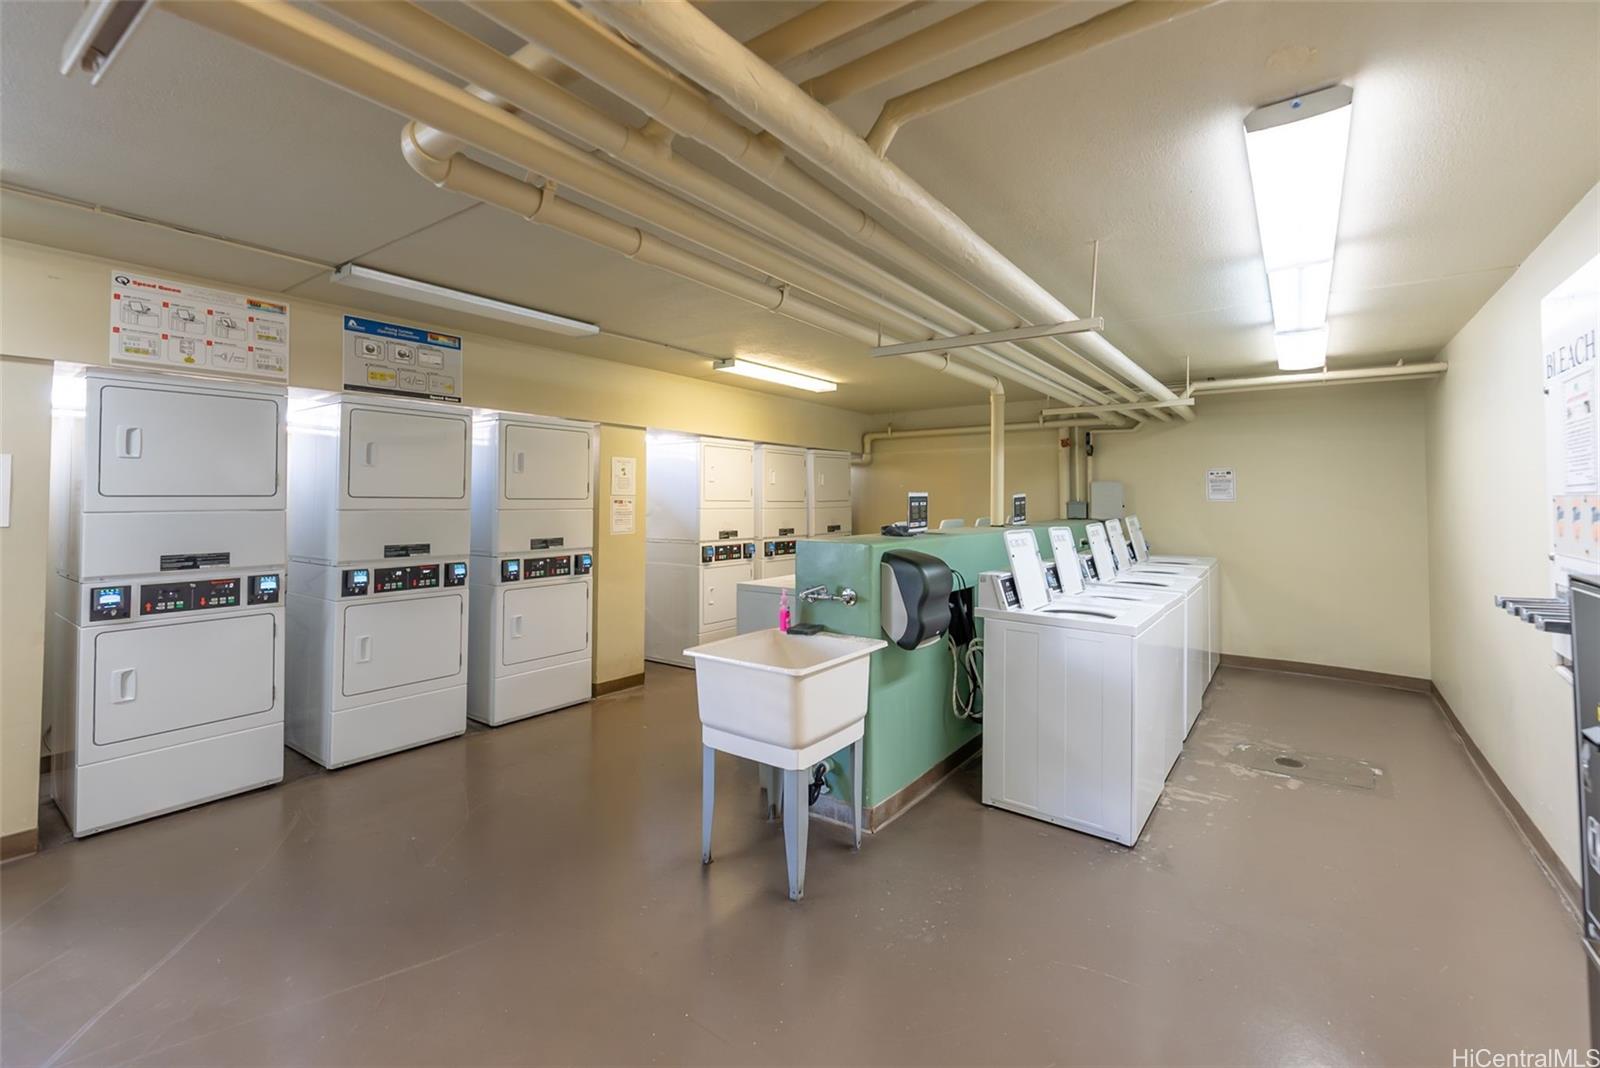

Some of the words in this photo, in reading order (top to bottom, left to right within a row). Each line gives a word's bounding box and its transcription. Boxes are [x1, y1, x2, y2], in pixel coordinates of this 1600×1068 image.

[132, 280, 156, 288] Speed
[158, 285, 181, 293] Queen
[1546, 330, 1596, 379] BLEACH
